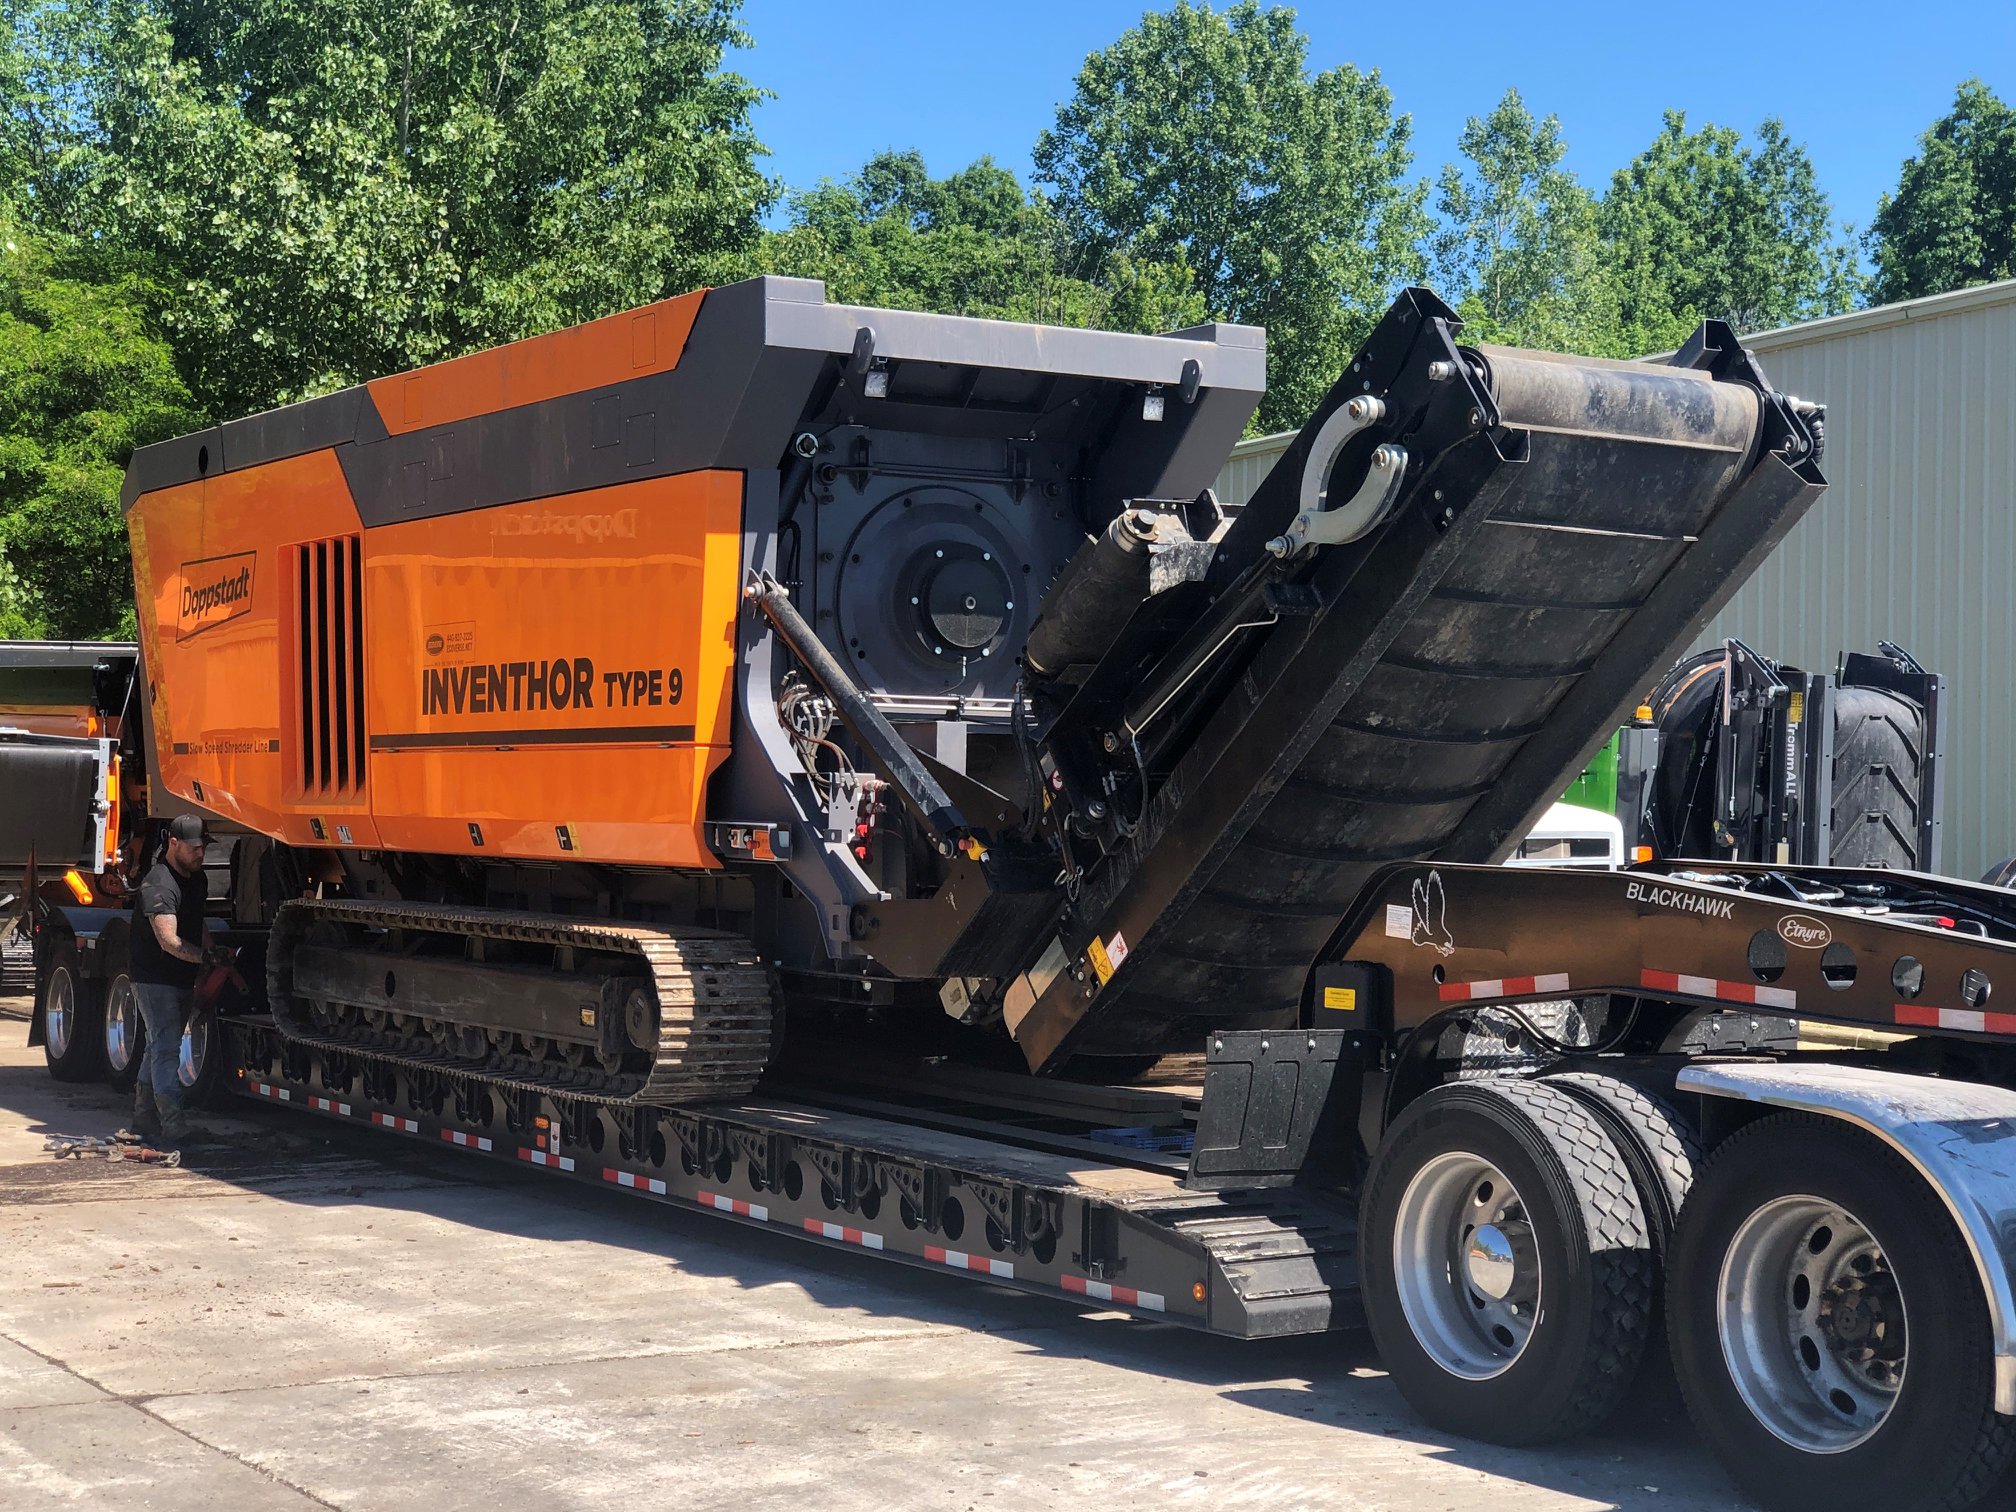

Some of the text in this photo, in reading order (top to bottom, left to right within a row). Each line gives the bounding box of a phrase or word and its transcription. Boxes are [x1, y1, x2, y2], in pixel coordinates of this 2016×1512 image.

[182, 566, 250, 620] Doppstadt
[422, 657, 683, 716] INVENTHOR TYPE 9
[189, 740, 268, 756] Slow Speed Shredder Line
[1785, 721, 1799, 797] TrommALL
[1626, 882, 1736, 920] BLACKHAWK
[1783, 919, 1826, 943] Etnyre
